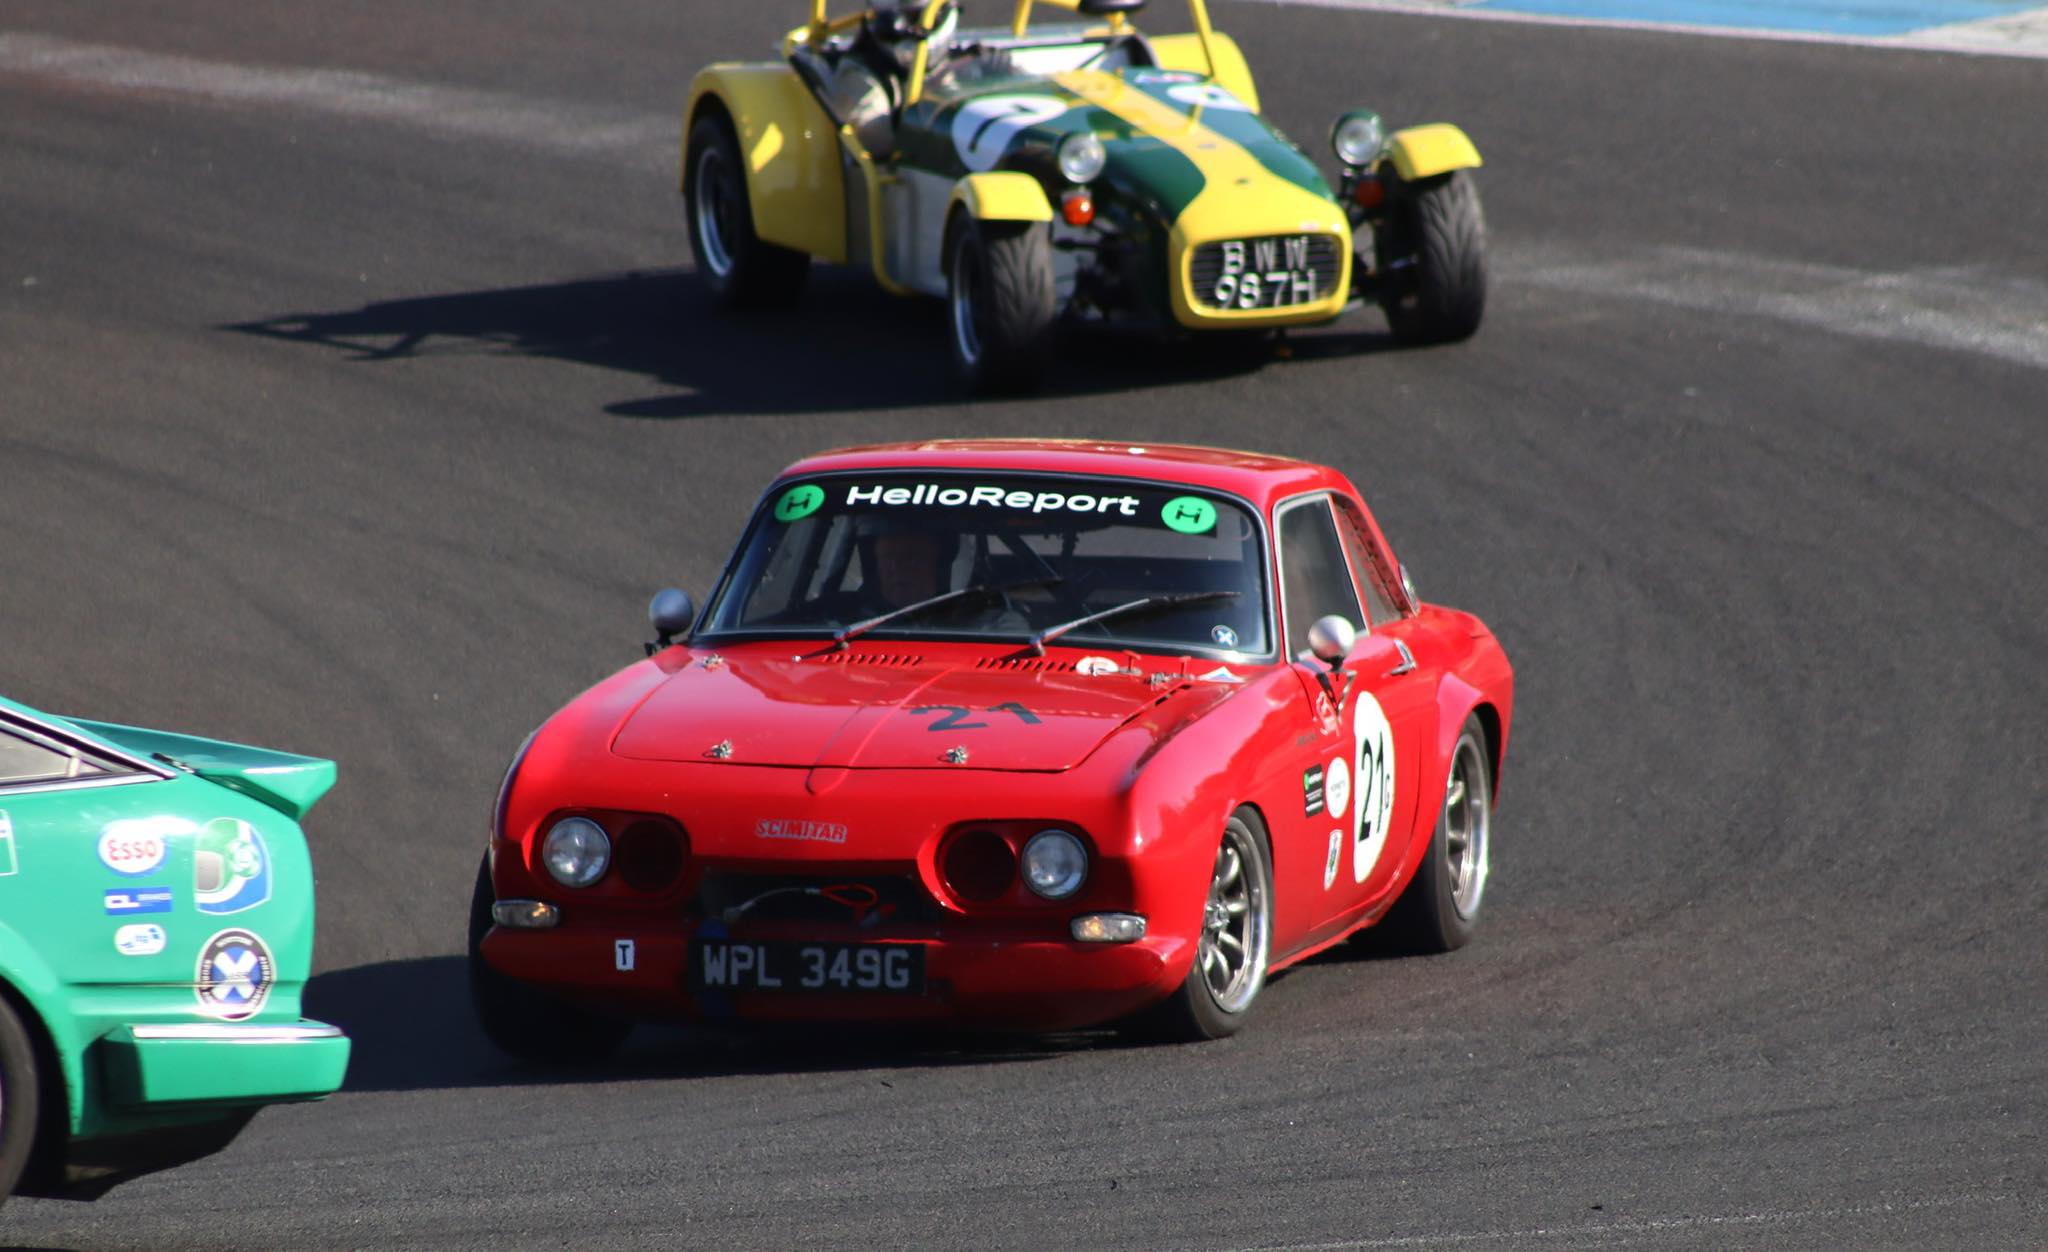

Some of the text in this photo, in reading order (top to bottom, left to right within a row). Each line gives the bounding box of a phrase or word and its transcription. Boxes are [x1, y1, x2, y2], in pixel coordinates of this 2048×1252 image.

[846, 485, 1140, 516] HelloReport
[910, 702, 1042, 732] 21
[1358, 731, 1384, 842] 21
[755, 818, 848, 844] SCIMITAR
[703, 944, 910, 987] WPL 349G
